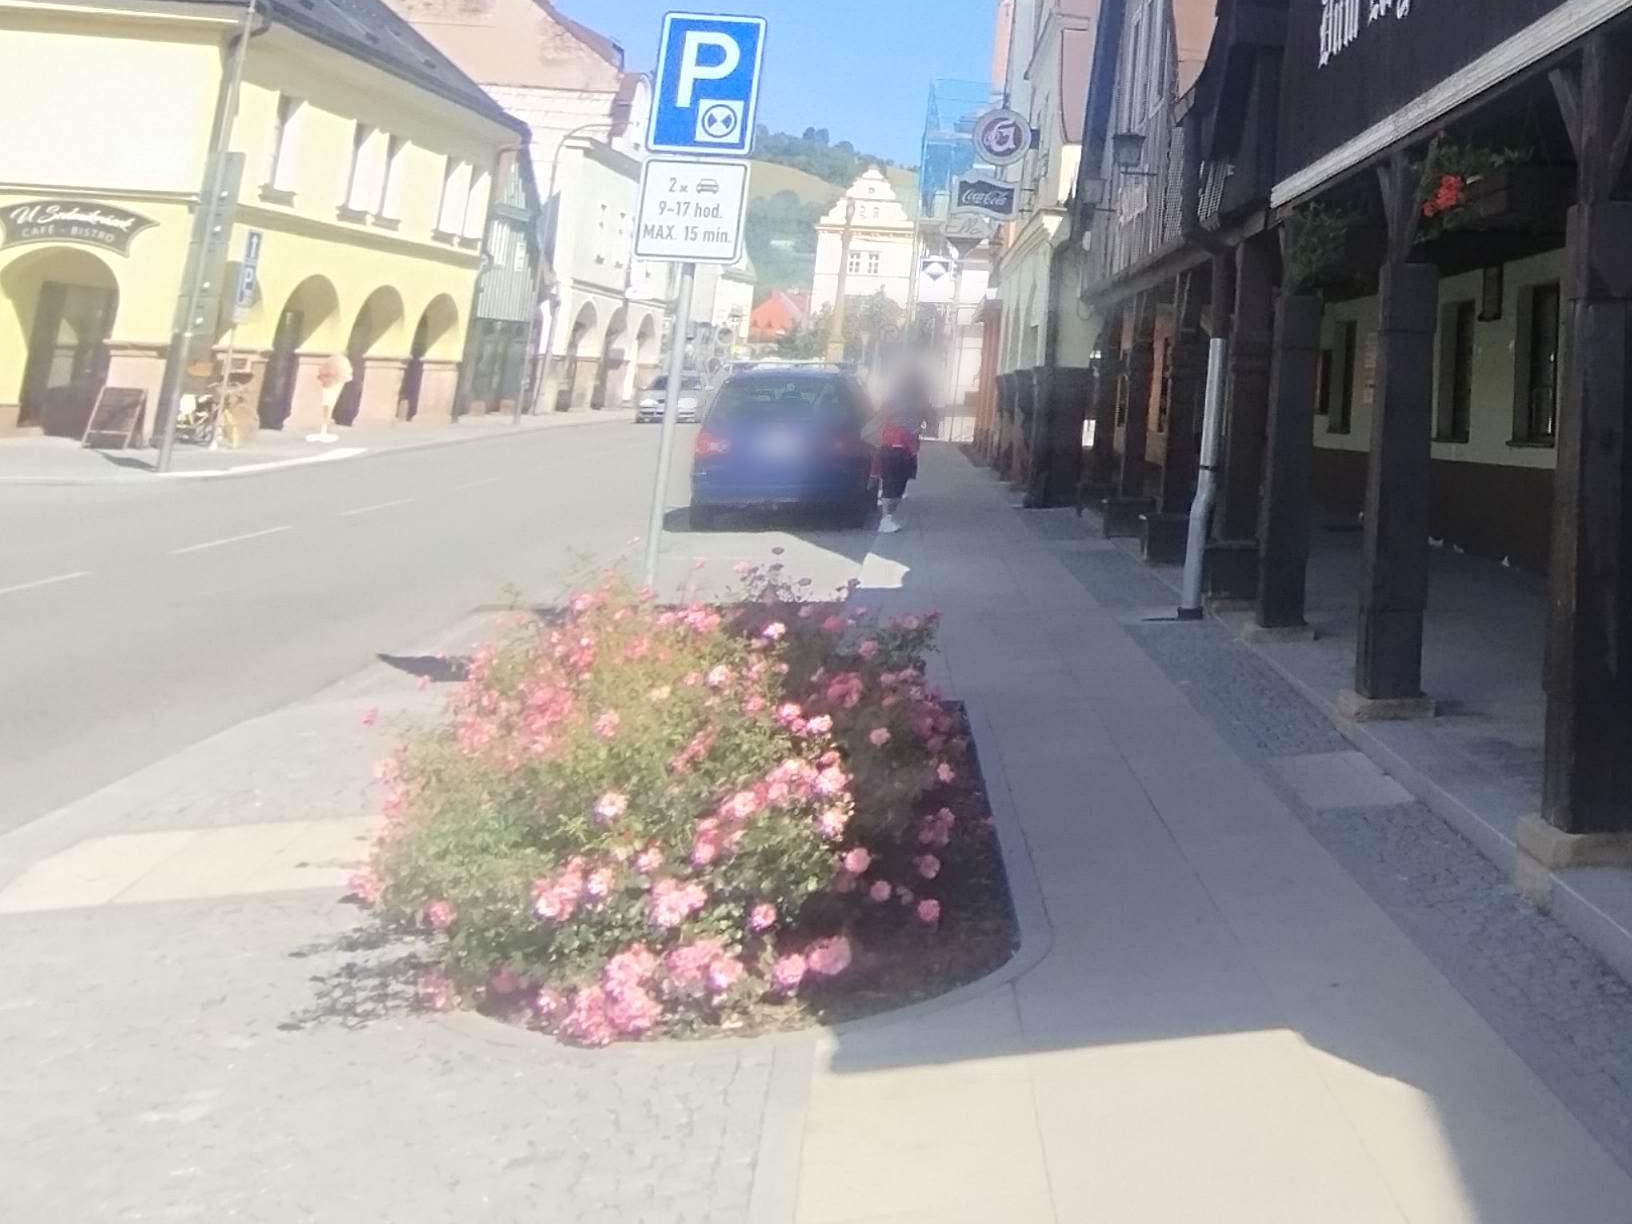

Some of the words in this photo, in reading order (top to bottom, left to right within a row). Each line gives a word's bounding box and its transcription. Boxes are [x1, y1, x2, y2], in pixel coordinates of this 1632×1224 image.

[675, 30, 741, 108] P
[667, 177, 677, 193] 2
[658, 201, 691, 217] 9-17
[693, 203, 723, 220] hod.
[20, 224, 55, 238] CAFÉ
[70, 225, 116, 243] BISTRO
[642, 223, 677, 241] MAX.
[683, 225, 698, 242] 15
[702, 227, 733, 244] min.
